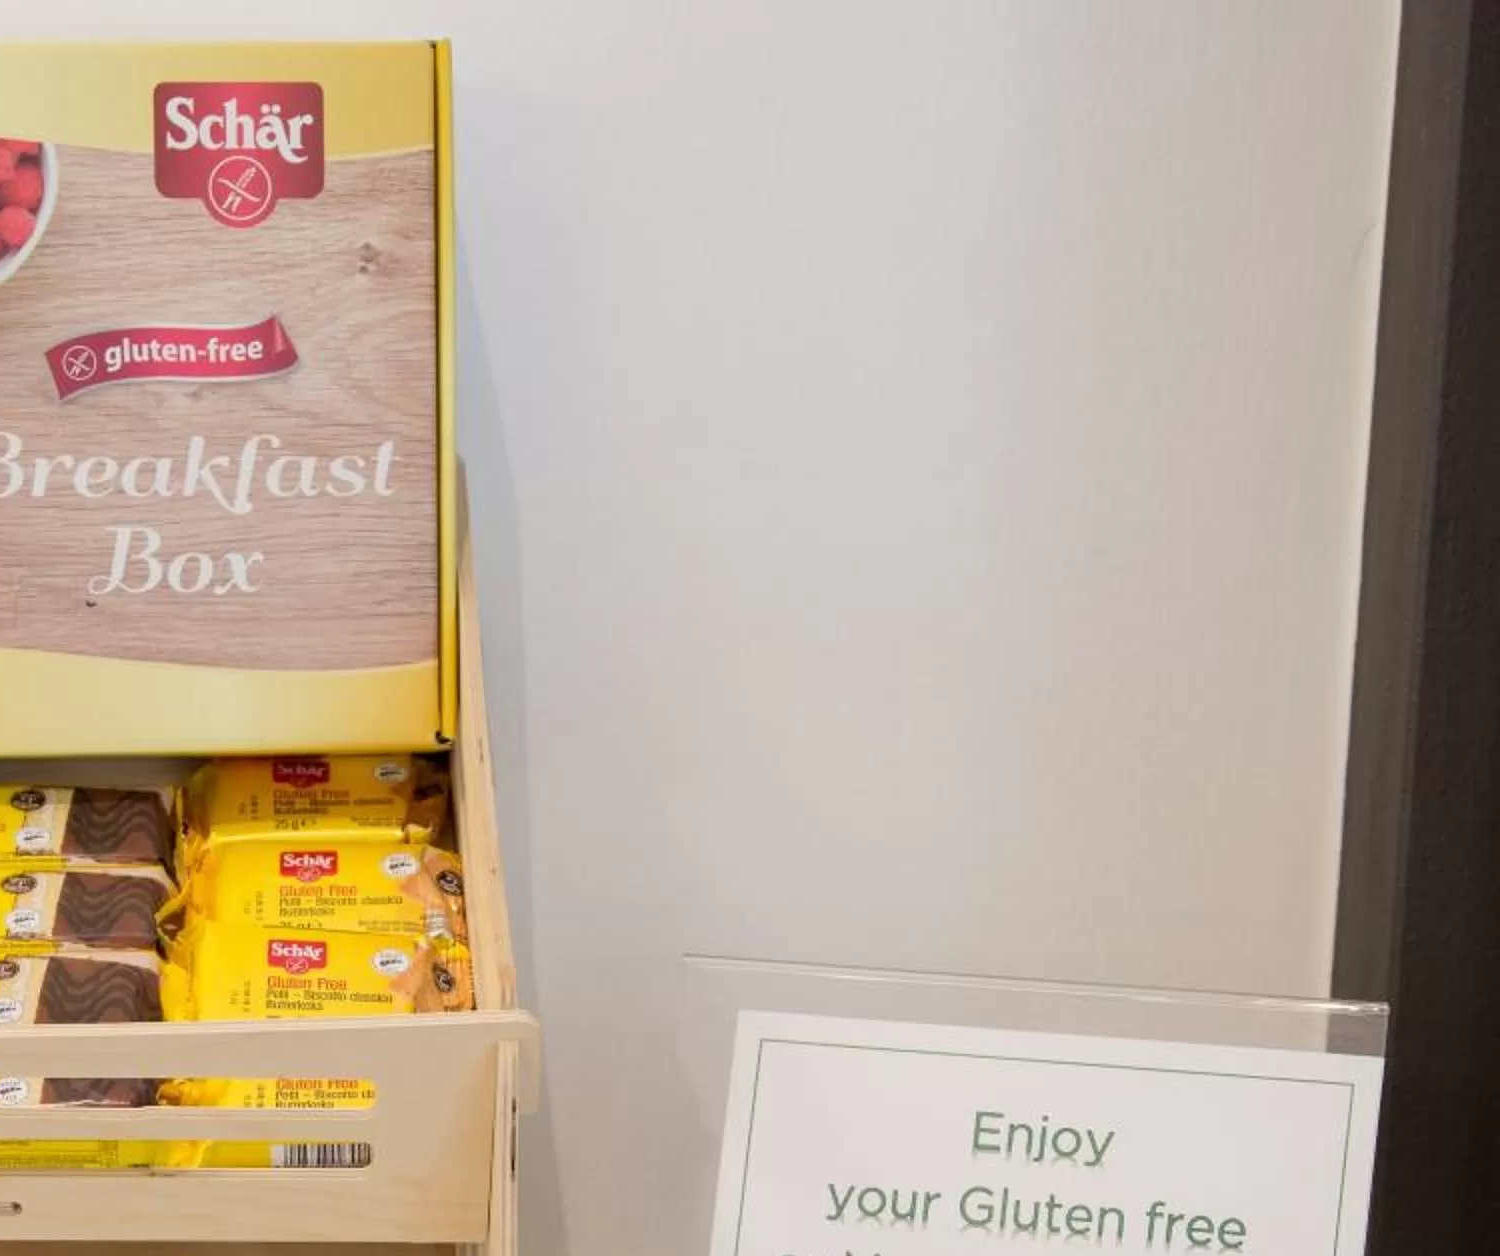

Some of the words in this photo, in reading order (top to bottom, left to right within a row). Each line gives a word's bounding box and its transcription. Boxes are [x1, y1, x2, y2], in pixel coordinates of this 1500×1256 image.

[164, 96, 313, 162] Schär
[104, 331, 266, 370] gluten-free
[88, 526, 264, 595] Box
[283, 853, 335, 869] Schär
[279, 885, 324, 897] Gluten
[329, 885, 358, 897] Free
[271, 942, 324, 959] Schär
[267, 975, 312, 989] Gluten
[317, 977, 348, 990] Free
[970, 1110, 1116, 1168] Enjoy
[826, 1183, 942, 1226] your
[958, 1185, 1126, 1241] Gluten
[1145, 1200, 1248, 1250] free
